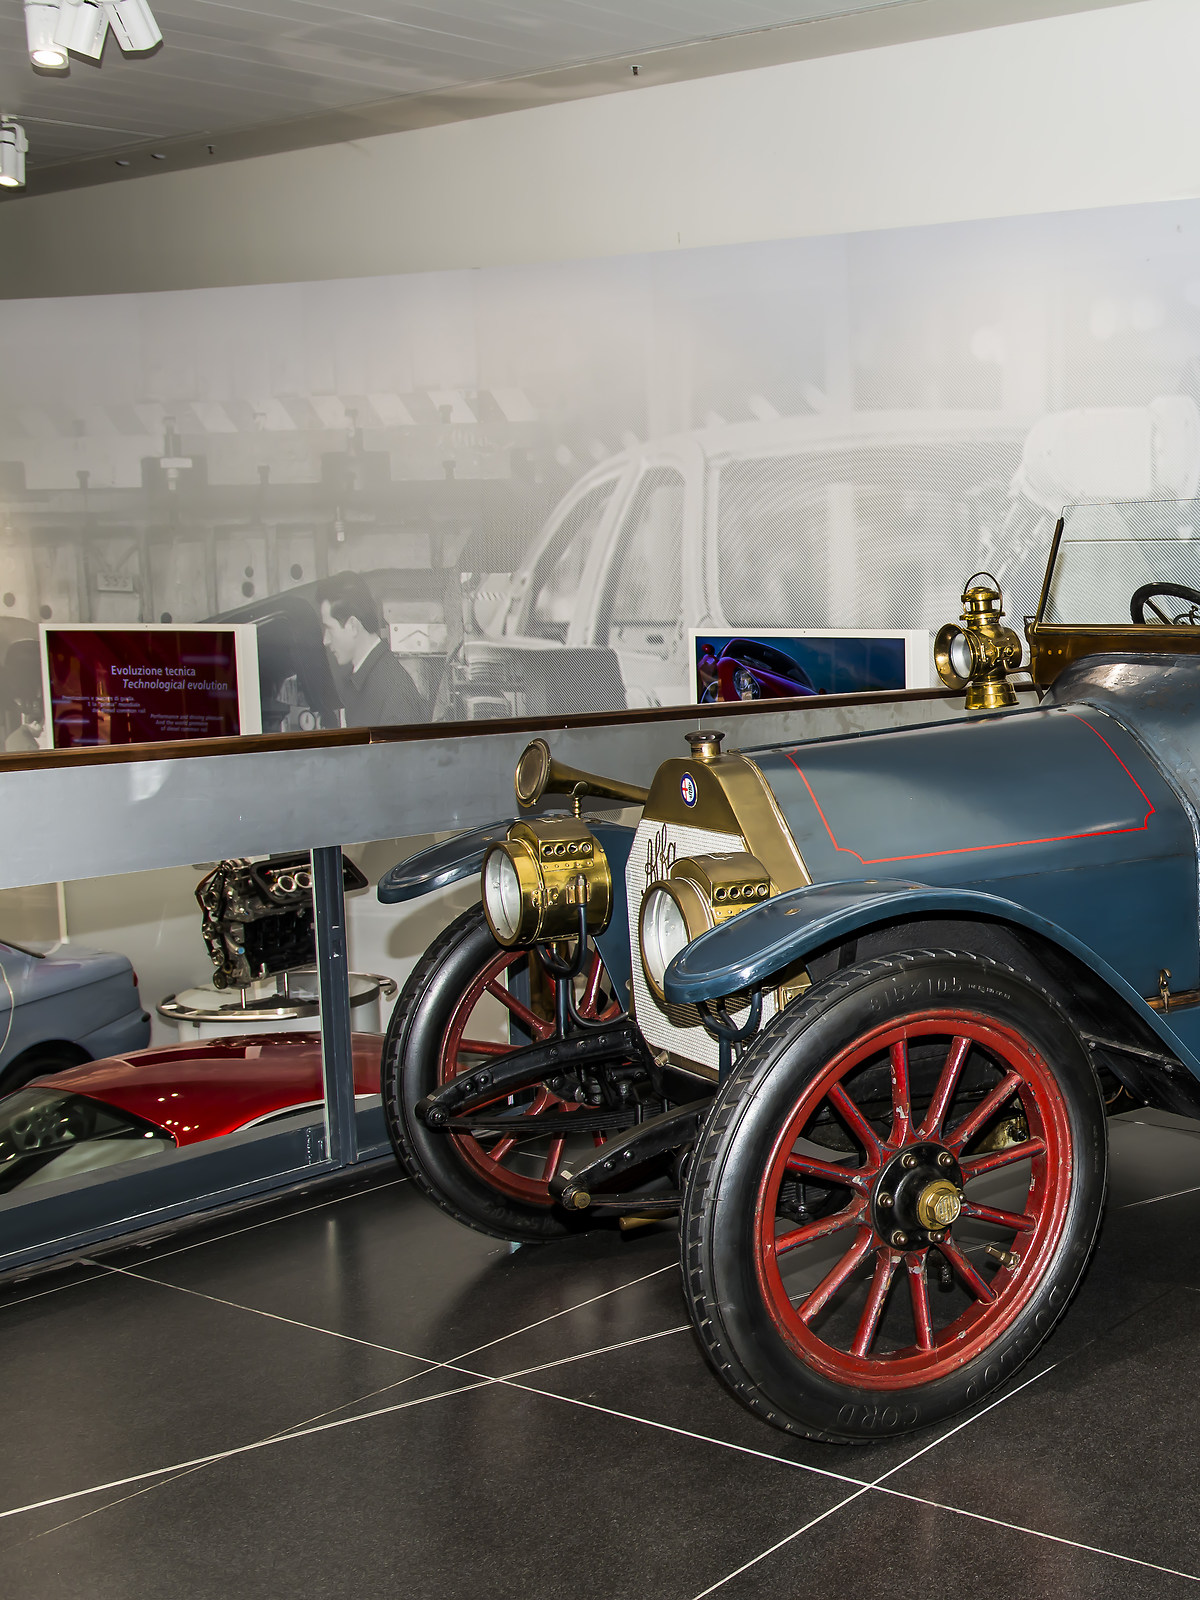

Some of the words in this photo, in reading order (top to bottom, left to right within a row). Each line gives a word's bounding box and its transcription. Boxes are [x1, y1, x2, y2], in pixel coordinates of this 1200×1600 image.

[111, 665, 163, 676] Evoluzione
[165, 665, 196, 677] tecnica
[122, 678, 185, 692] Technological
[187, 679, 228, 691] evolution
[836, 1401, 919, 1430] CORD
